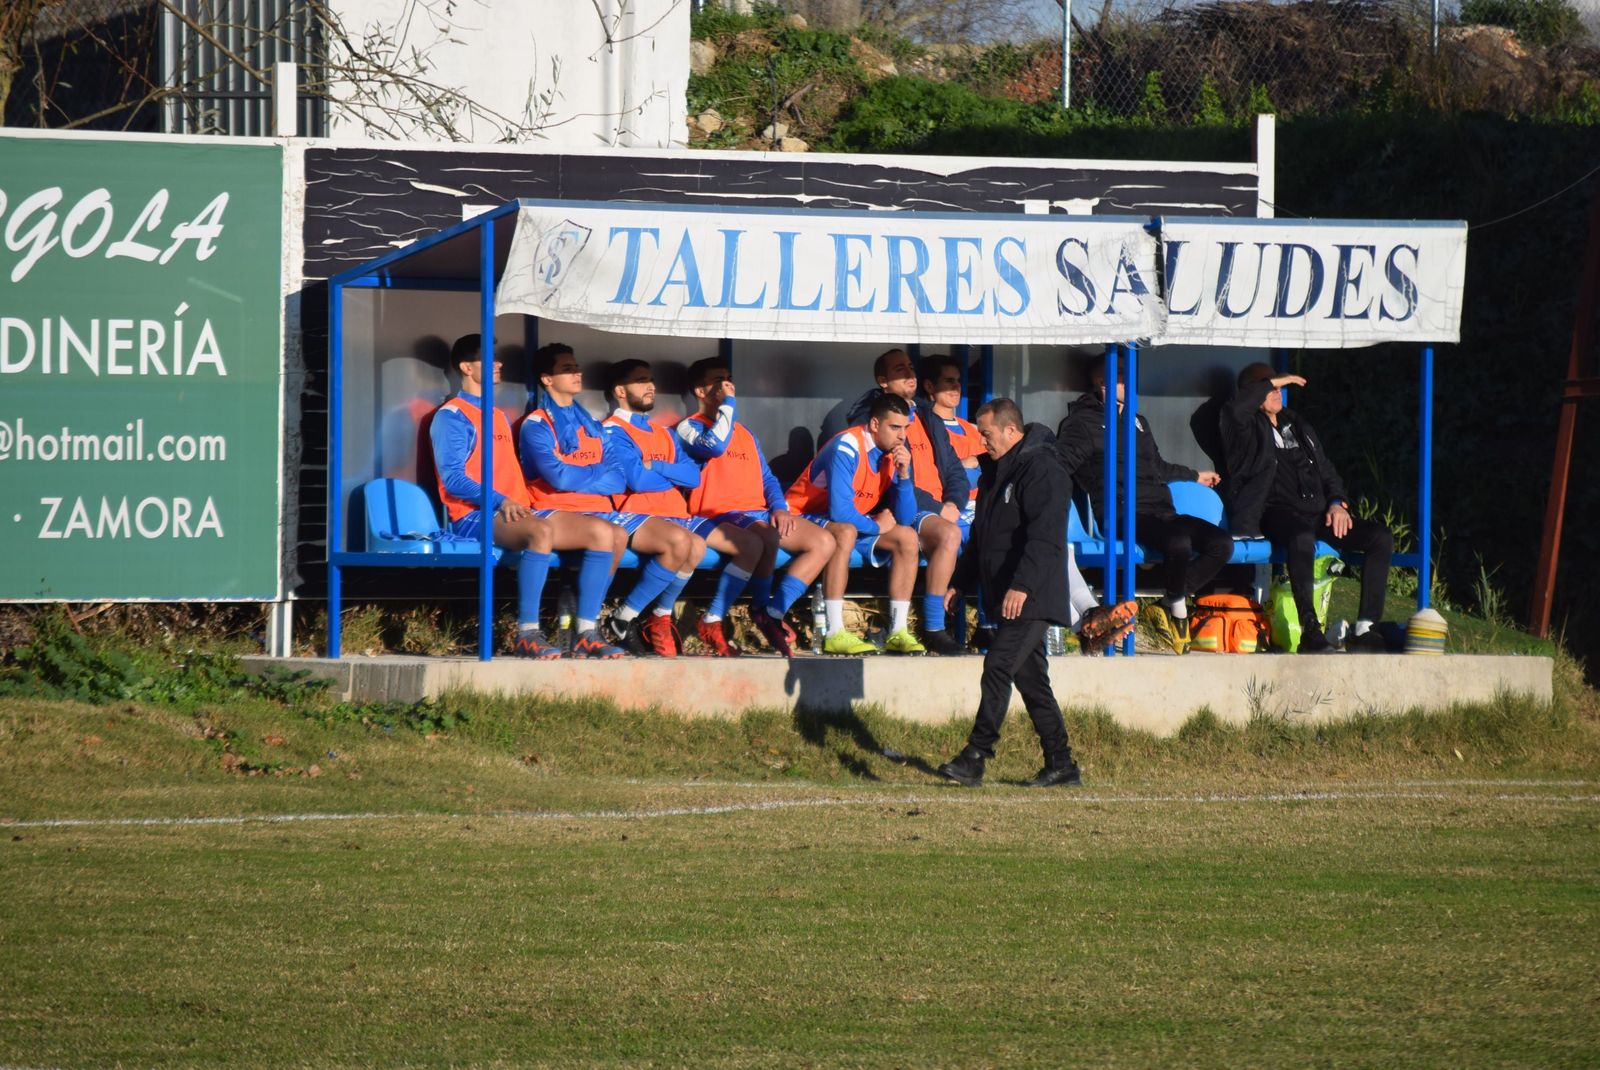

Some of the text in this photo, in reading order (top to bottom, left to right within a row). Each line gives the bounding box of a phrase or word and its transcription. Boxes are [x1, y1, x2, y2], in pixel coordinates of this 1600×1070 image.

[0, 187, 229, 283] GOLA
[606, 226, 1421, 322] TALLERES SALUDES
[0, 302, 227, 377] DINERÍA
[38, 496, 224, 539] ZAMORA
